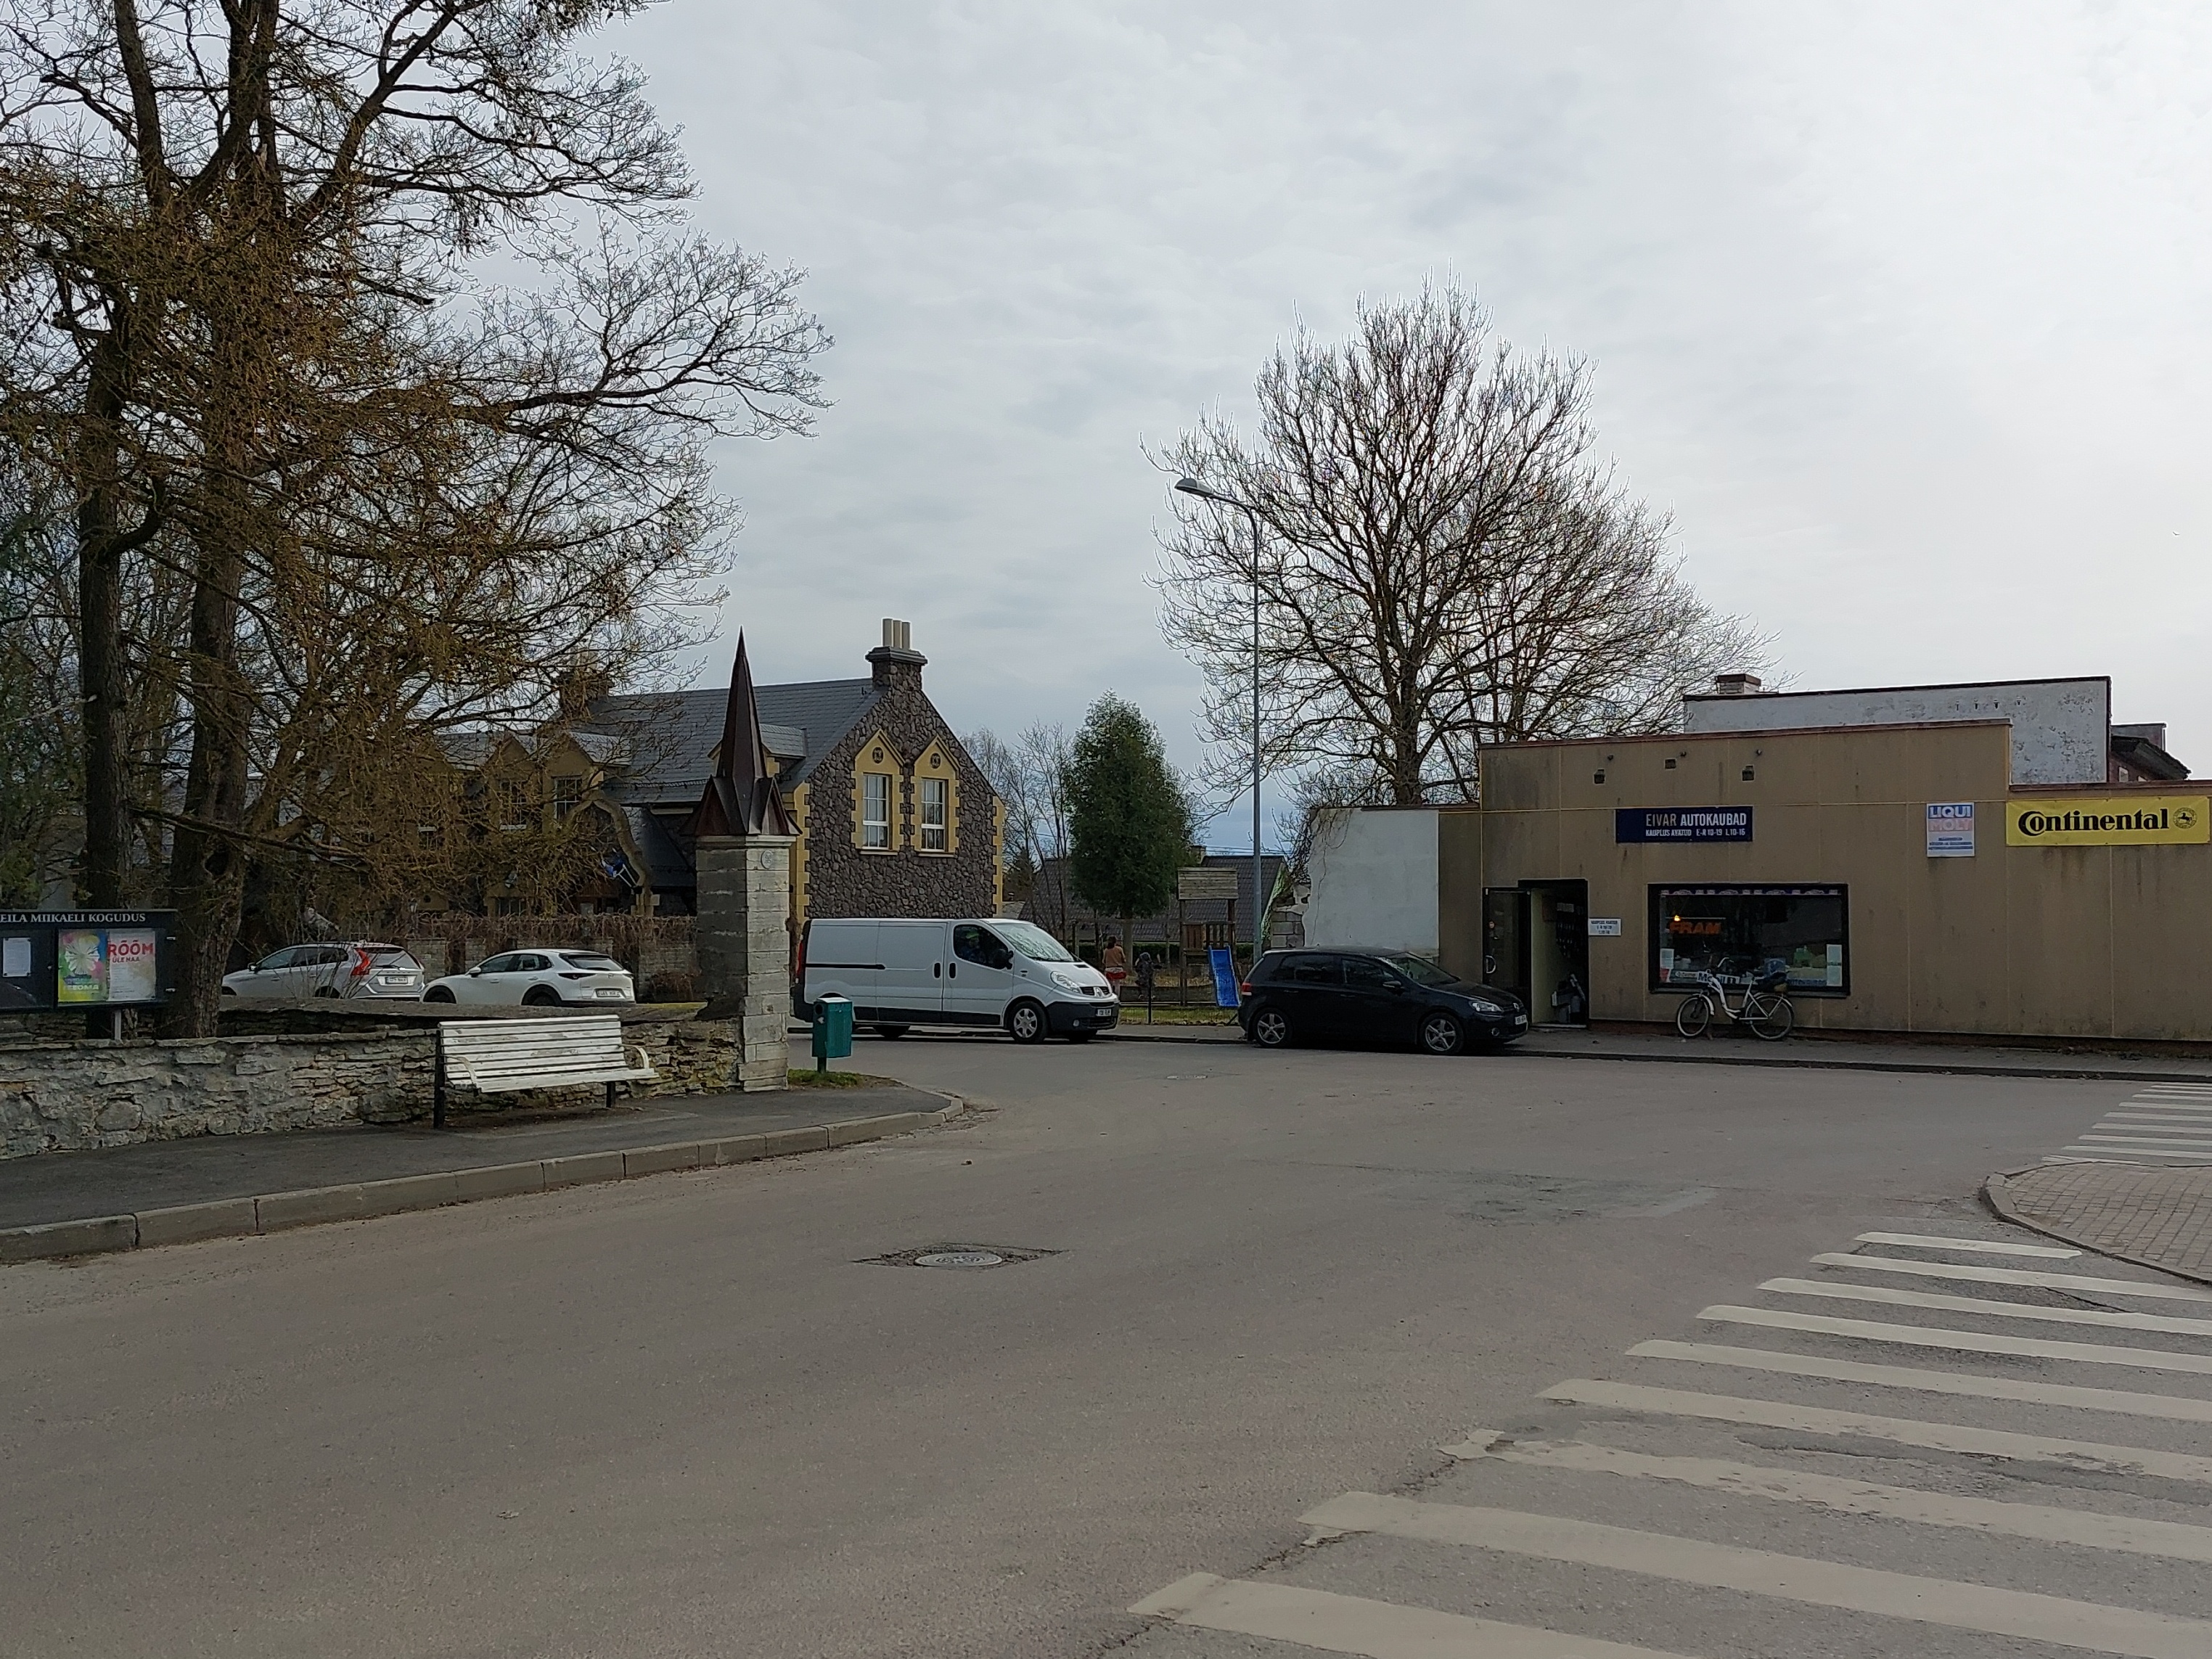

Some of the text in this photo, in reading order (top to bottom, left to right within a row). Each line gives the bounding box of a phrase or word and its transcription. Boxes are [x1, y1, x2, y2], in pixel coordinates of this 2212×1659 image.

[1929, 806, 1971, 818] LIQUI
[1645, 813, 1747, 827] EIVAR AUTOKAUBAD
[2018, 808, 2170, 837] Continental
[30, 914, 85, 922] MIIKAELI
[89, 913, 146, 922] KOGUDUS
[107, 940, 153, 957] RÕÕM
